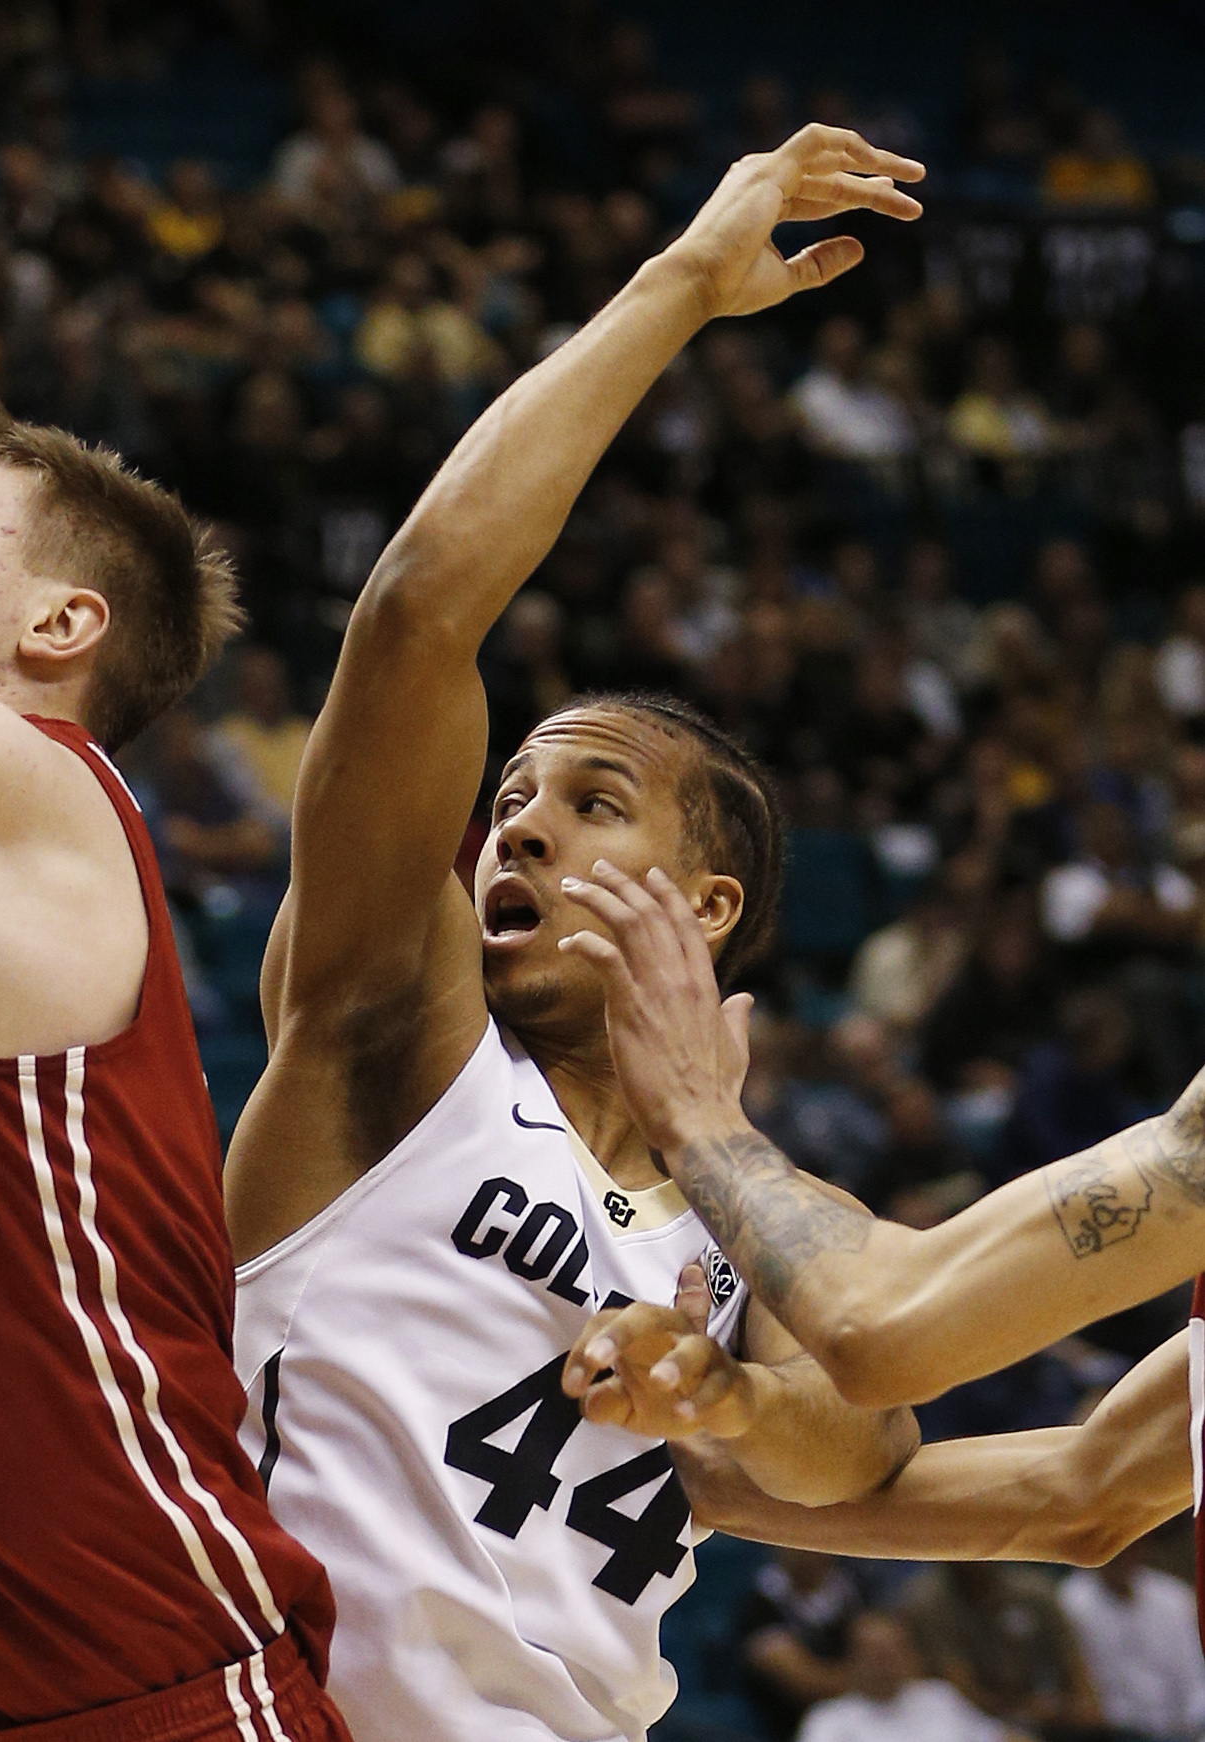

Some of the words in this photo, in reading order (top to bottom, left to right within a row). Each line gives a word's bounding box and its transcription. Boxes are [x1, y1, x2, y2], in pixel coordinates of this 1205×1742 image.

[450, 1176, 636, 1310] COL
[714, 1274, 733, 1296] 12
[443, 1350, 690, 1606] 44
